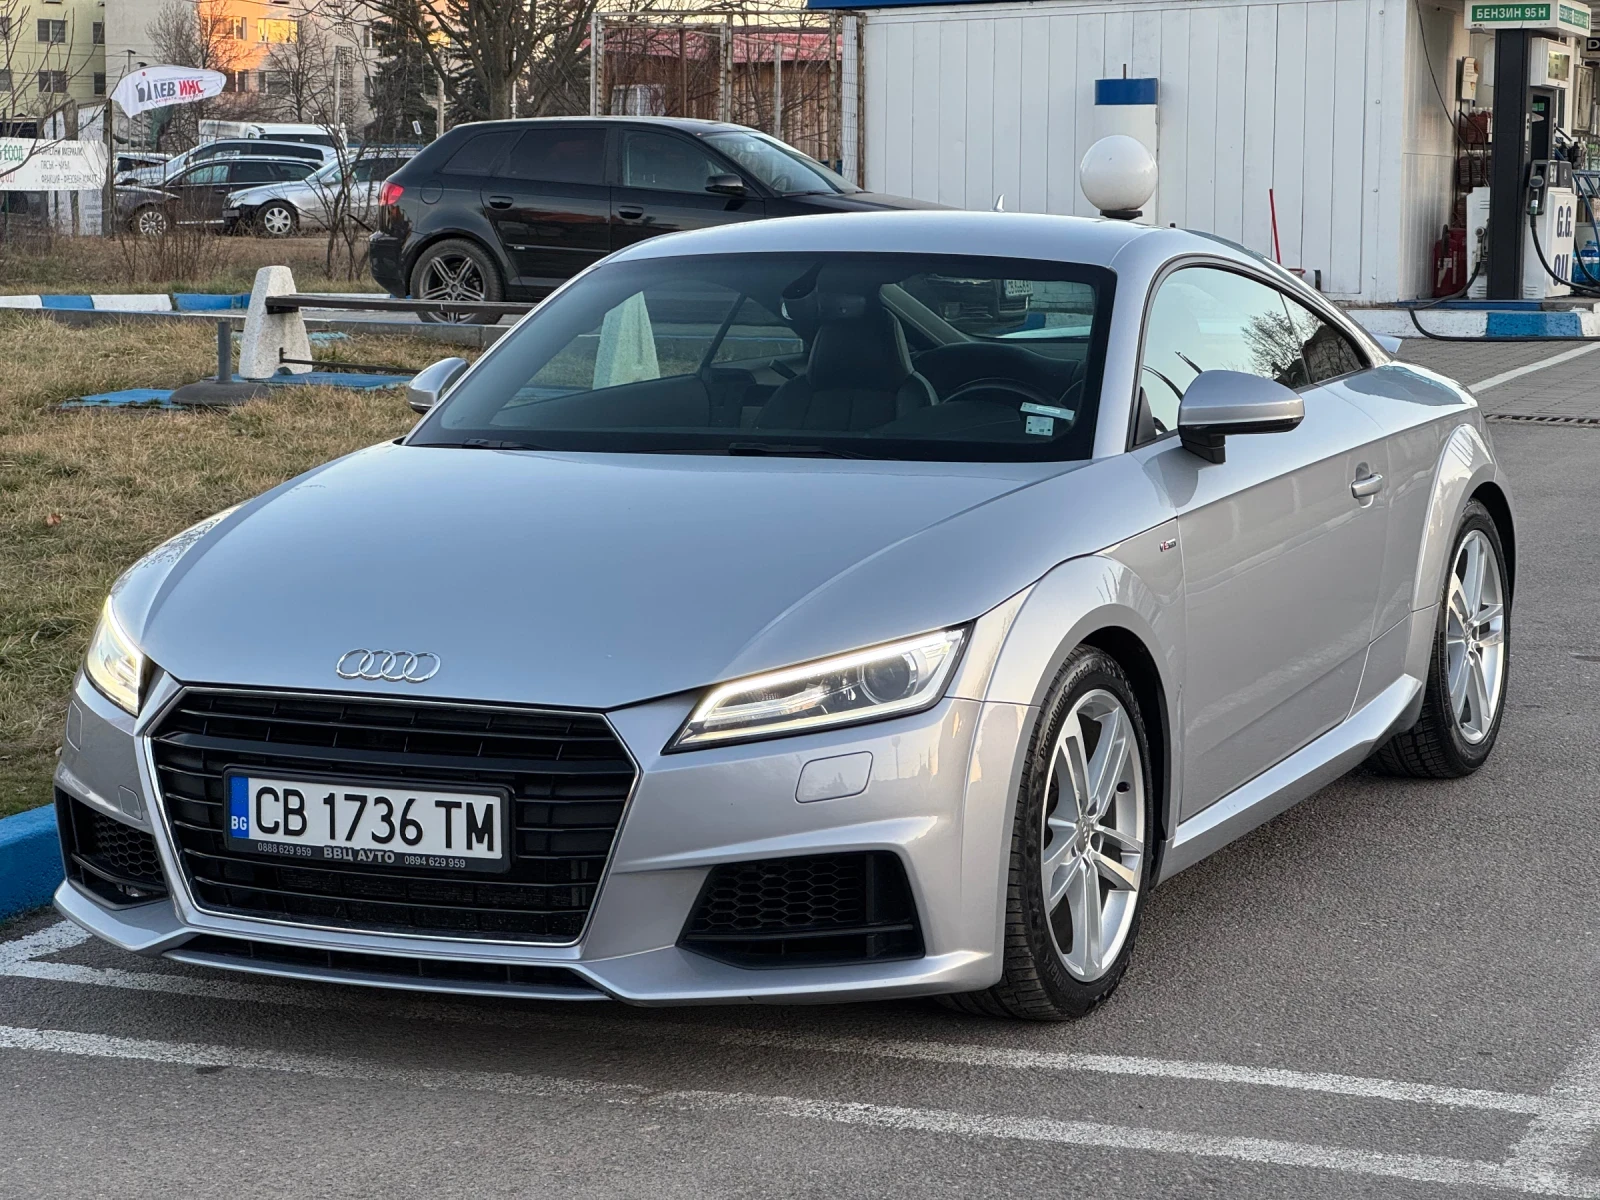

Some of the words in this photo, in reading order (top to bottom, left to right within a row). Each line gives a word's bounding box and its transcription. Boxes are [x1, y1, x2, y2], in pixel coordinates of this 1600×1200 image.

[1476, 8, 1521, 19] БЕНЗИН
[1524, 8, 1536, 18] 95
[154, 82, 175, 99] ЛЕВ
[179, 80, 203, 96] ИНС
[1552, 254, 1569, 287] OIL
[231, 815, 247, 831] BG
[255, 786, 308, 837] CB
[323, 792, 423, 847] 1736
[435, 800, 495, 852] TM
[257, 842, 278, 854] 0888
[278, 845, 295, 855] 629
[295, 846, 312, 857] 959
[323, 846, 354, 862] ВВЦ
[357, 849, 395, 864] АУТО
[404, 855, 427, 866] 0894
[428, 856, 447, 867] 629
[448, 858, 466, 869] 959
